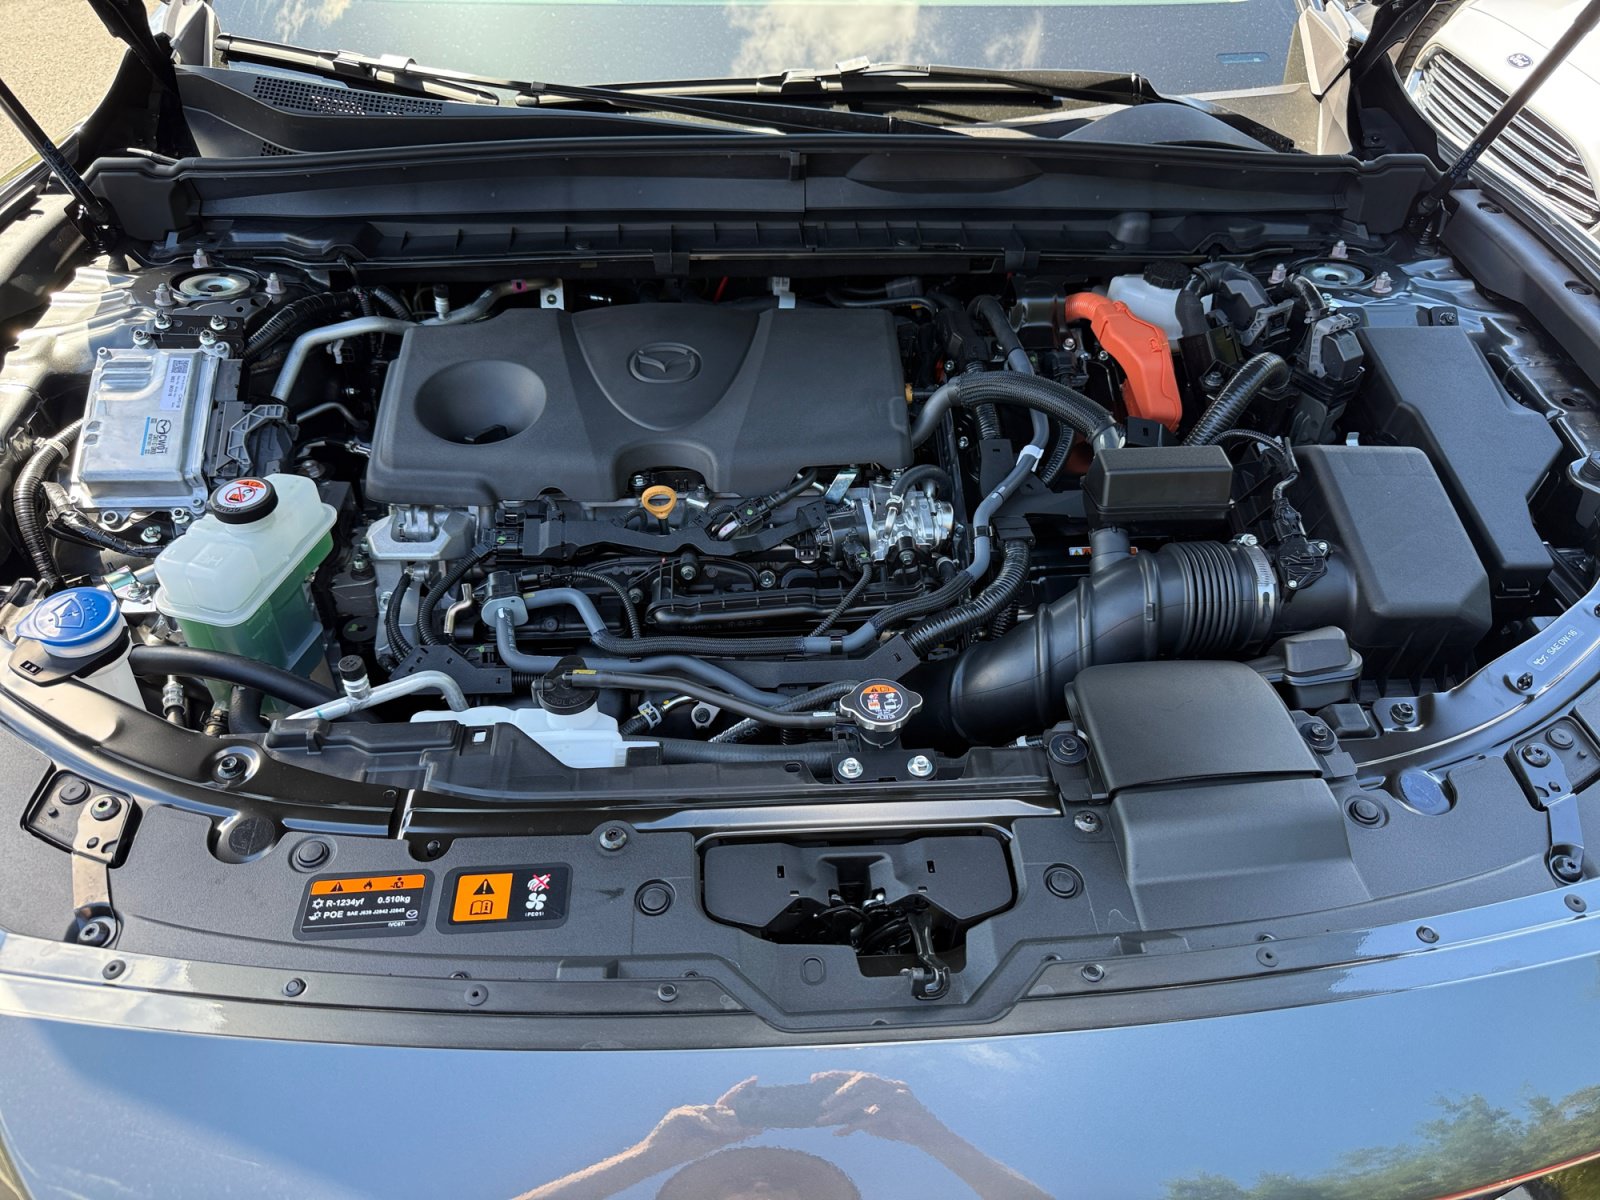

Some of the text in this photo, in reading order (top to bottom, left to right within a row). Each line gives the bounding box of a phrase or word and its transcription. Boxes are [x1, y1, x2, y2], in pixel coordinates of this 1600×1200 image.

[1547, 643, 1561, 655] SAE
[325, 895, 411, 908] R-1234yf 0.510kg
[323, 910, 344, 919] POE
